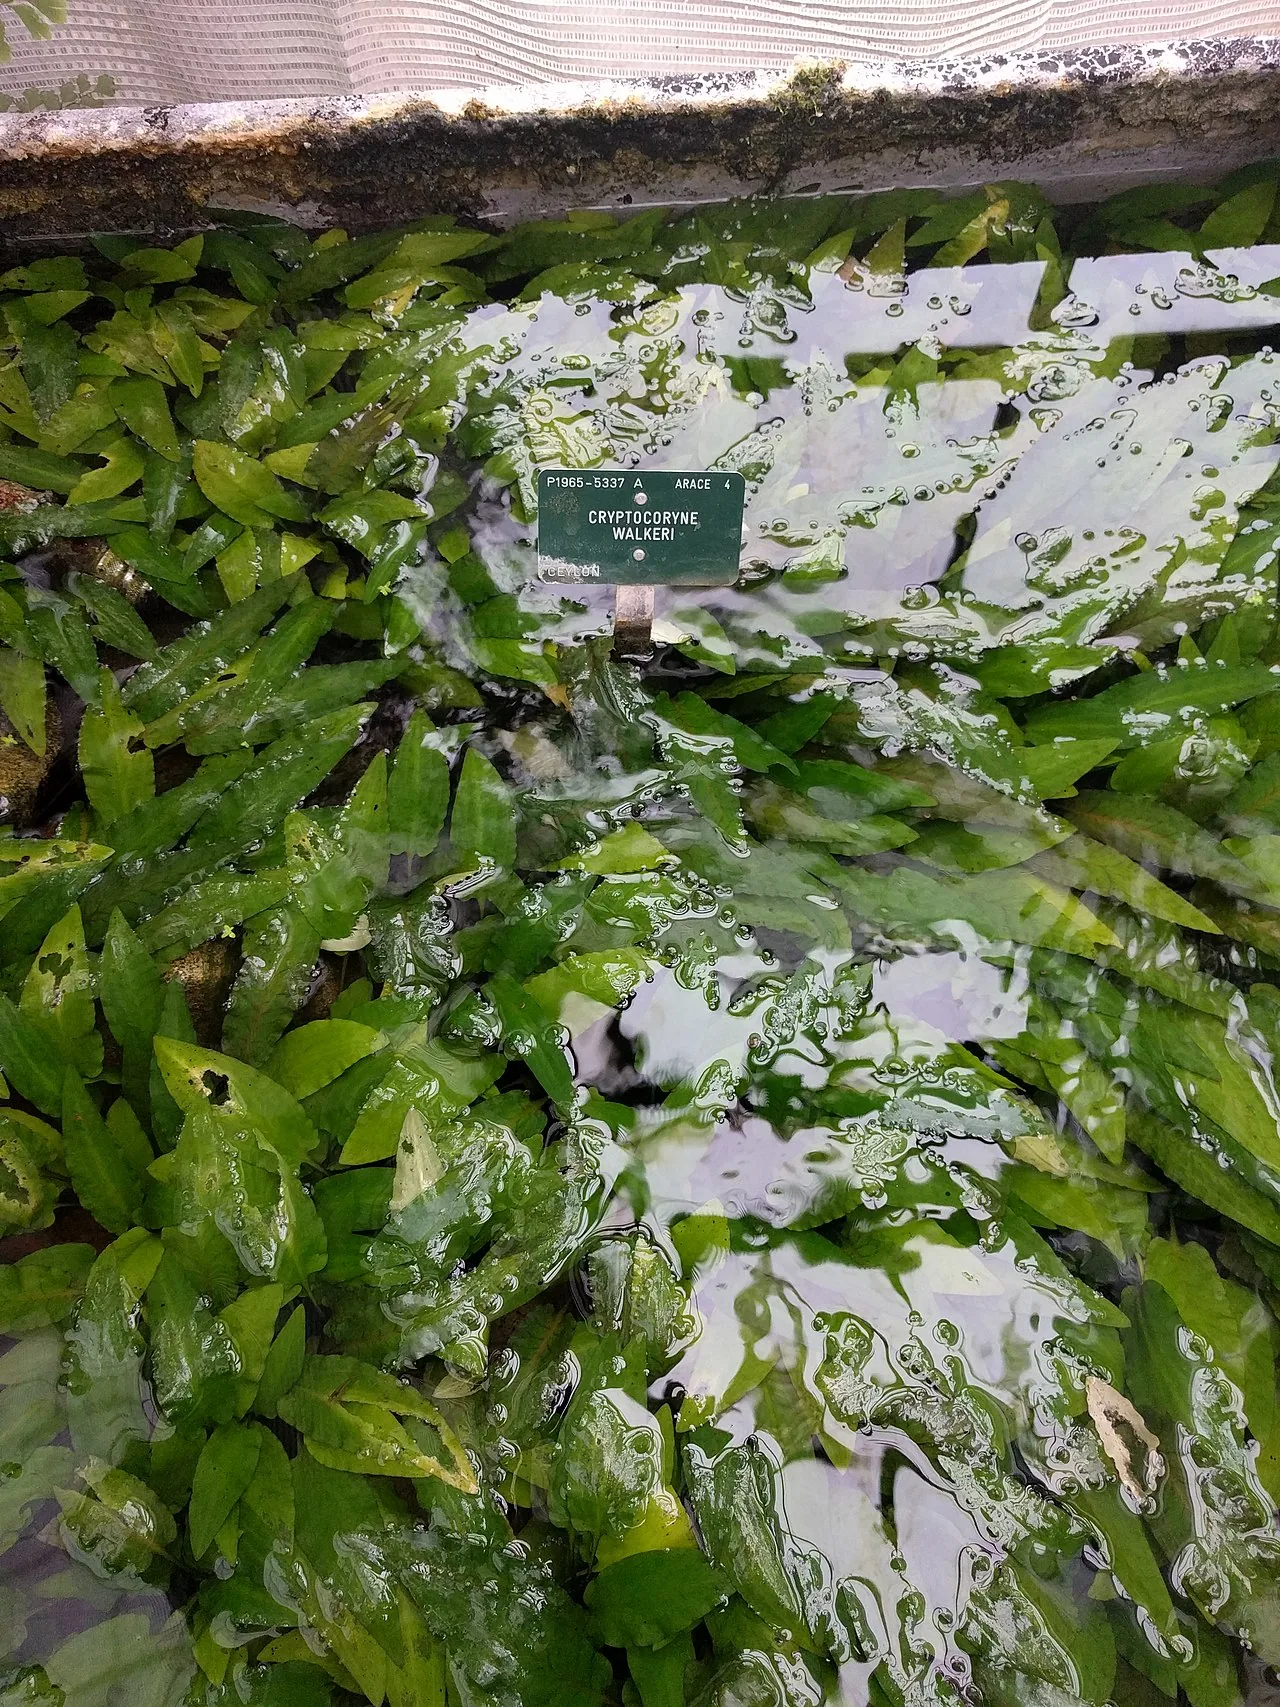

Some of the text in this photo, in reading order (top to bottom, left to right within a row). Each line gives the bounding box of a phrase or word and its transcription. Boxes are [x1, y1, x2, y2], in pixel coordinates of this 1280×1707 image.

[547, 477, 731, 490] P1965-5337 A ARACE 4
[588, 510, 699, 525] CRYPTOCORYNE
[612, 527, 675, 541] WALKERI
[547, 565, 600, 577] CEYLON
